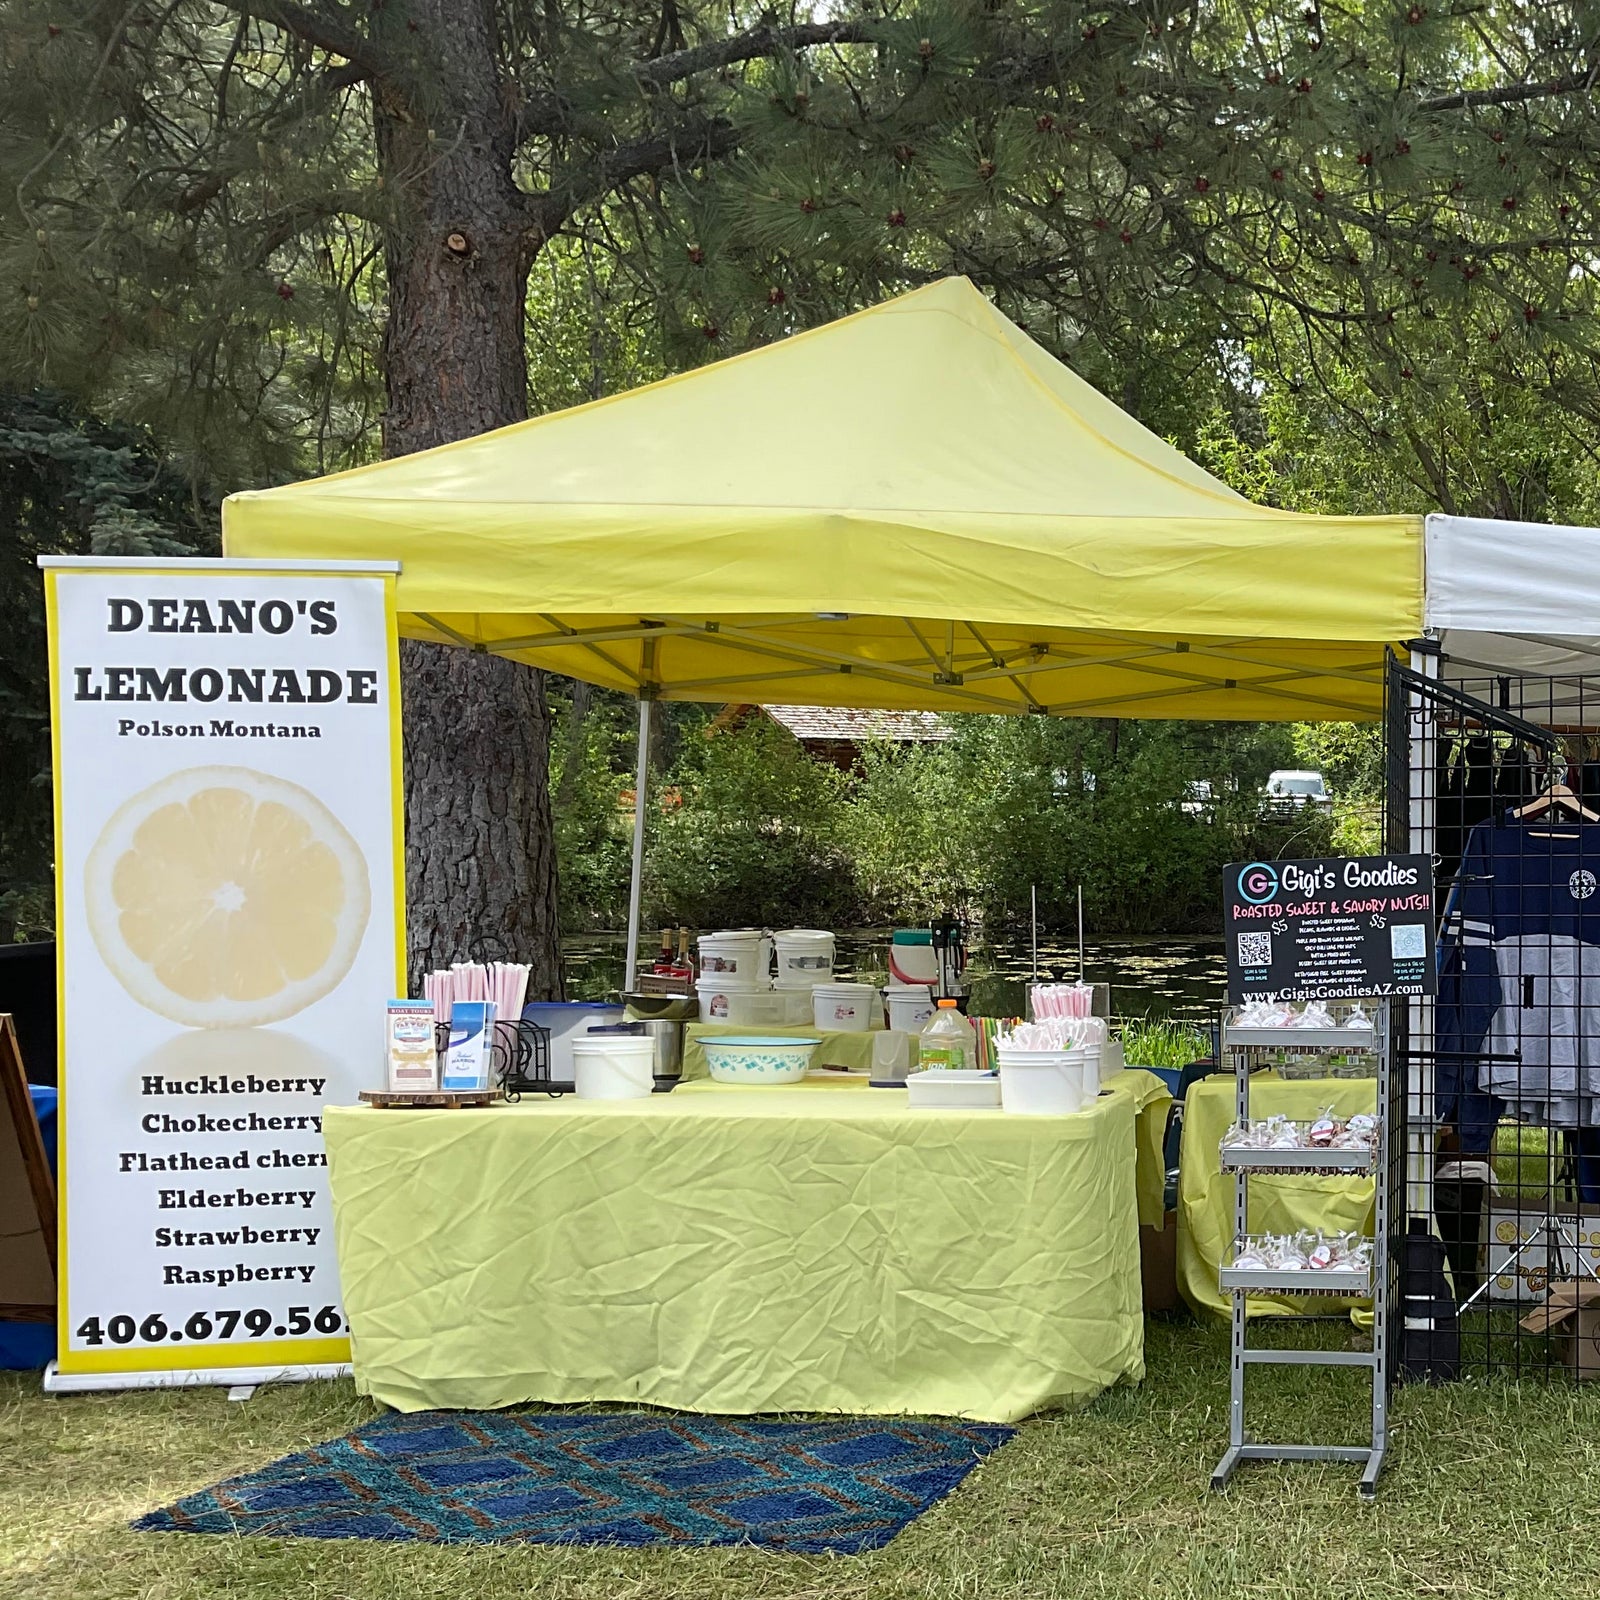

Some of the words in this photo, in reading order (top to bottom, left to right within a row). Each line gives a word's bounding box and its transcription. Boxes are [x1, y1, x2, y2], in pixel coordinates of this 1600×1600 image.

[108, 599, 337, 634] DEANO'S
[75, 668, 377, 703] LEMONADE
[119, 720, 204, 736] Polson
[210, 721, 320, 737] Montana
[1282, 864, 1335, 898] Gigi's
[1344, 861, 1418, 887] Goodies
[1233, 903, 1282, 920] ROASTED
[1286, 902, 1326, 916] SWEET
[1331, 902, 1339, 914] &
[1343, 898, 1387, 914] SAVORY
[1390, 894, 1430, 911] NUTS!!
[1271, 918, 1288, 936] $5
[1370, 913, 1387, 930] $5
[1242, 983, 1424, 1002] www.GigisGoodiesAZ.com
[142, 1075, 325, 1095] Huckleberry
[142, 1113, 321, 1133] Chokecherry
[120, 1151, 249, 1171] Flathead
[257, 1150, 327, 1168] cherr
[159, 1189, 315, 1208] Elderberry
[156, 1226, 320, 1246] Strawberry
[164, 1264, 315, 1286] Raspberry
[77, 1306, 349, 1345] 406.679.56
